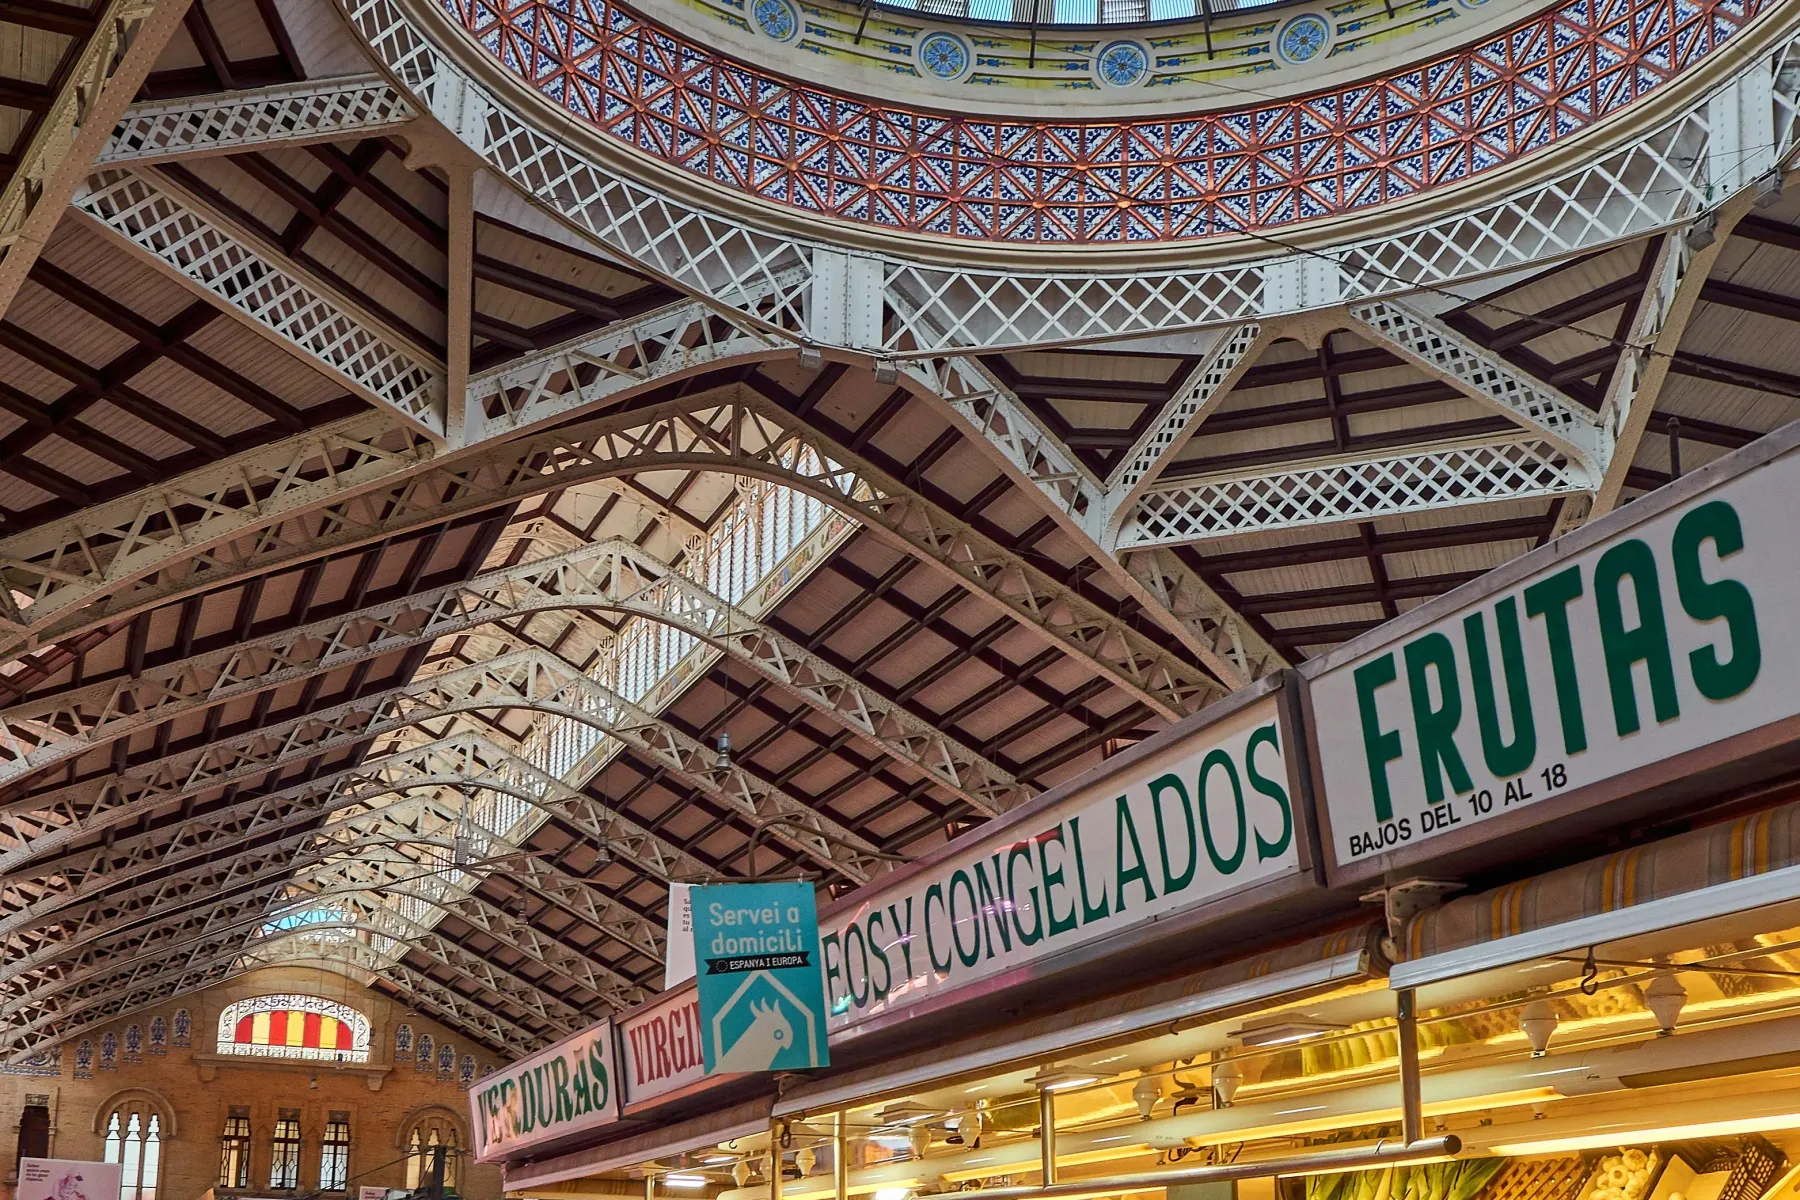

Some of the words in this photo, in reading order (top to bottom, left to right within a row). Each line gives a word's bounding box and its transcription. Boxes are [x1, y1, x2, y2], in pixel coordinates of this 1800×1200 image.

[1354, 500, 1762, 824] FRUTAS
[887, 896, 913, 988] Y
[924, 722, 1293, 984] CONGELADOS
[1349, 818, 1412, 857] BAJOS
[1421, 804, 1461, 832] DEL
[1468, 790, 1493, 816] 10
[1503, 777, 1534, 806] AL
[1541, 763, 1568, 791] 18
[709, 902, 780, 926] Servei
[787, 907, 800, 923] a
[711, 930, 803, 955] domicili
[729, 959, 765, 970] ESPANYA
[766, 958, 771, 967] I
[772, 956, 803, 967] EUROPA
[477, 1038, 609, 1148] VERDURAS
